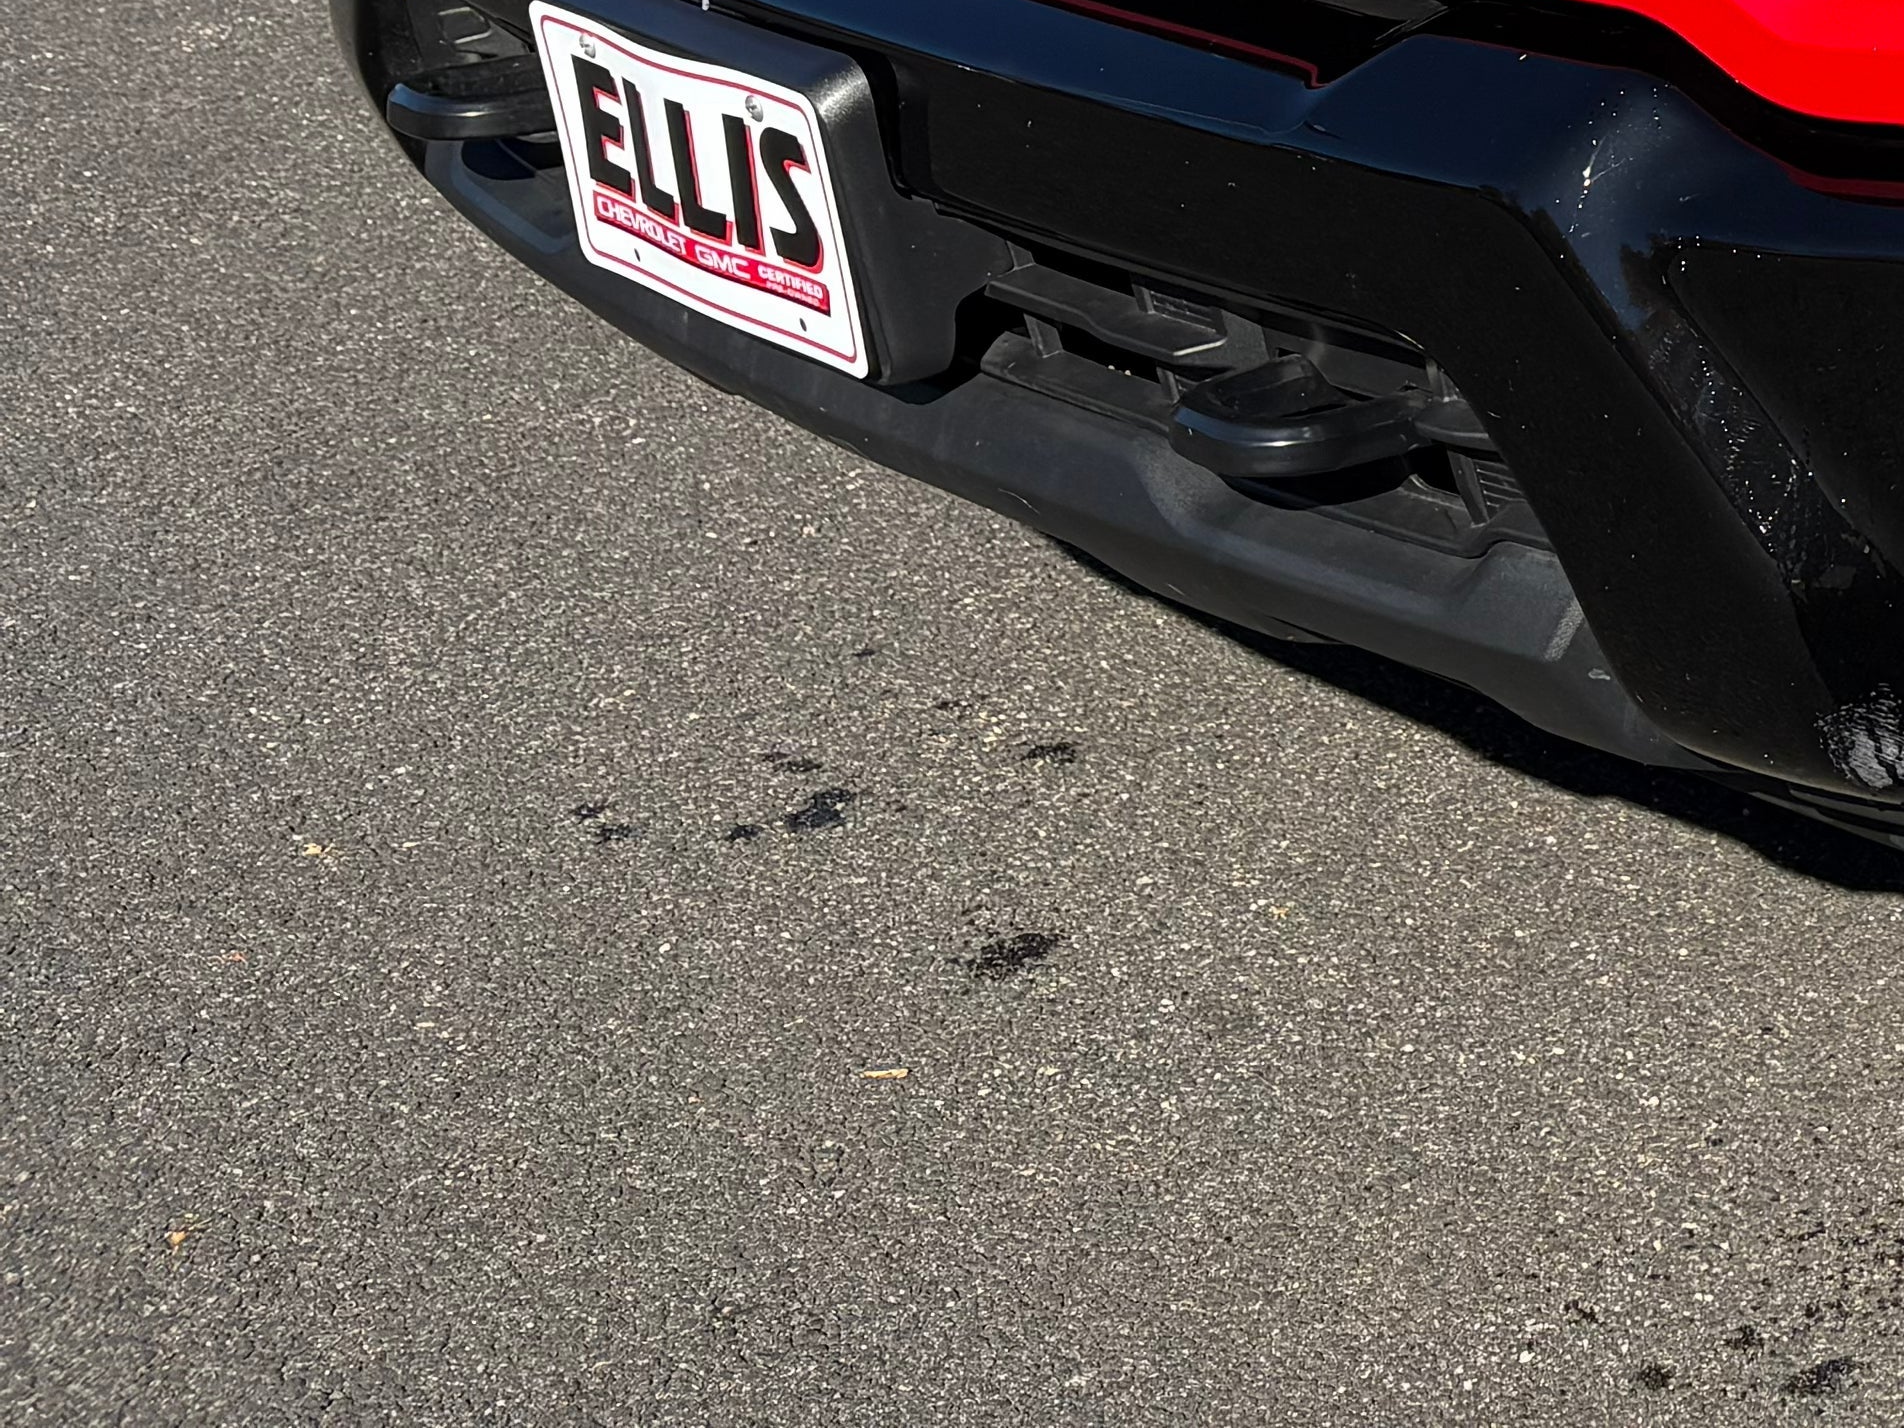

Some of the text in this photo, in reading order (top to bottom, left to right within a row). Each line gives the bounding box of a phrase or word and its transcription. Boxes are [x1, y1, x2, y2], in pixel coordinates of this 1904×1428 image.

[570, 53, 823, 273] ELLIS
[596, 195, 824, 300] CHEVROLET GMC CERTIFIED
